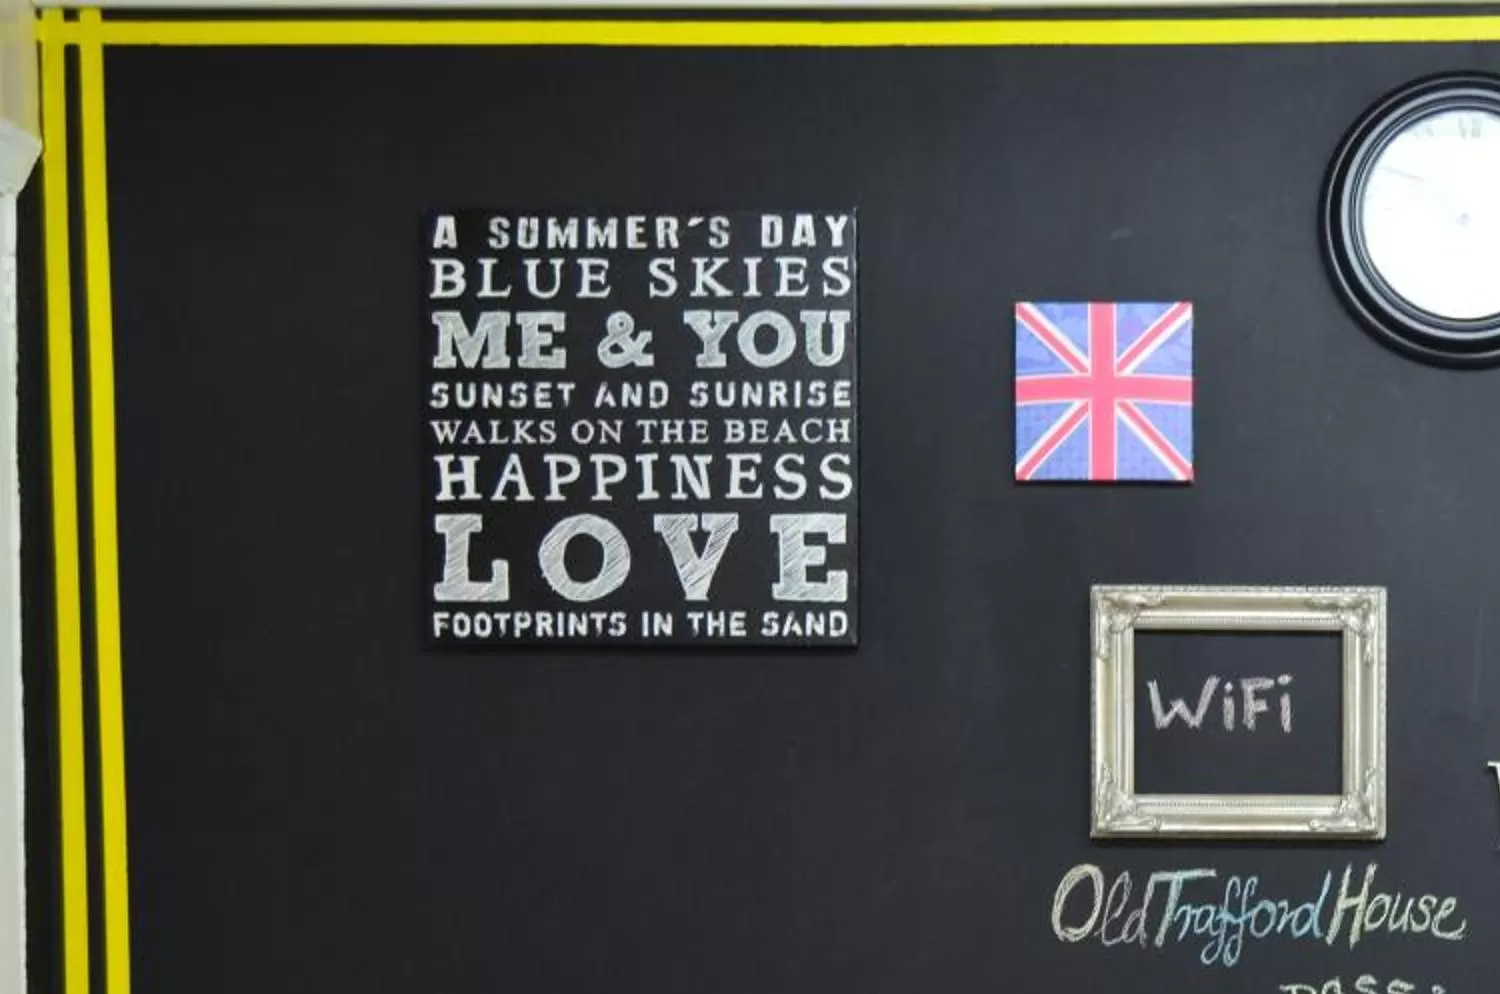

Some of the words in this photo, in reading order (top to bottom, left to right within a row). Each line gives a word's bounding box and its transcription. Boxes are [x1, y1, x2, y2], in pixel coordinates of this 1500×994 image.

[432, 214, 458, 249] A
[760, 214, 850, 249] DAY
[429, 257, 612, 299] BLUE
[648, 256, 853, 299] SKIES
[432, 310, 567, 369] ME
[597, 311, 655, 369] &
[683, 309, 851, 369] YOU
[429, 381, 576, 409] SUNSET
[594, 380, 670, 409] AND
[689, 380, 852, 408] SUNRISE
[429, 419, 558, 444] WALKS
[571, 418, 624, 443] ON
[635, 418, 709, 443] THE
[724, 418, 852, 443] BEACH
[432, 453, 854, 502] HAPPINESS
[432, 512, 849, 603] LOVE
[432, 610, 627, 638] FOOTPRINTS
[641, 610, 673, 638] IN
[687, 610, 747, 638] THE
[760, 610, 849, 638] SAND
[1146, 673, 1294, 734] WiFi
